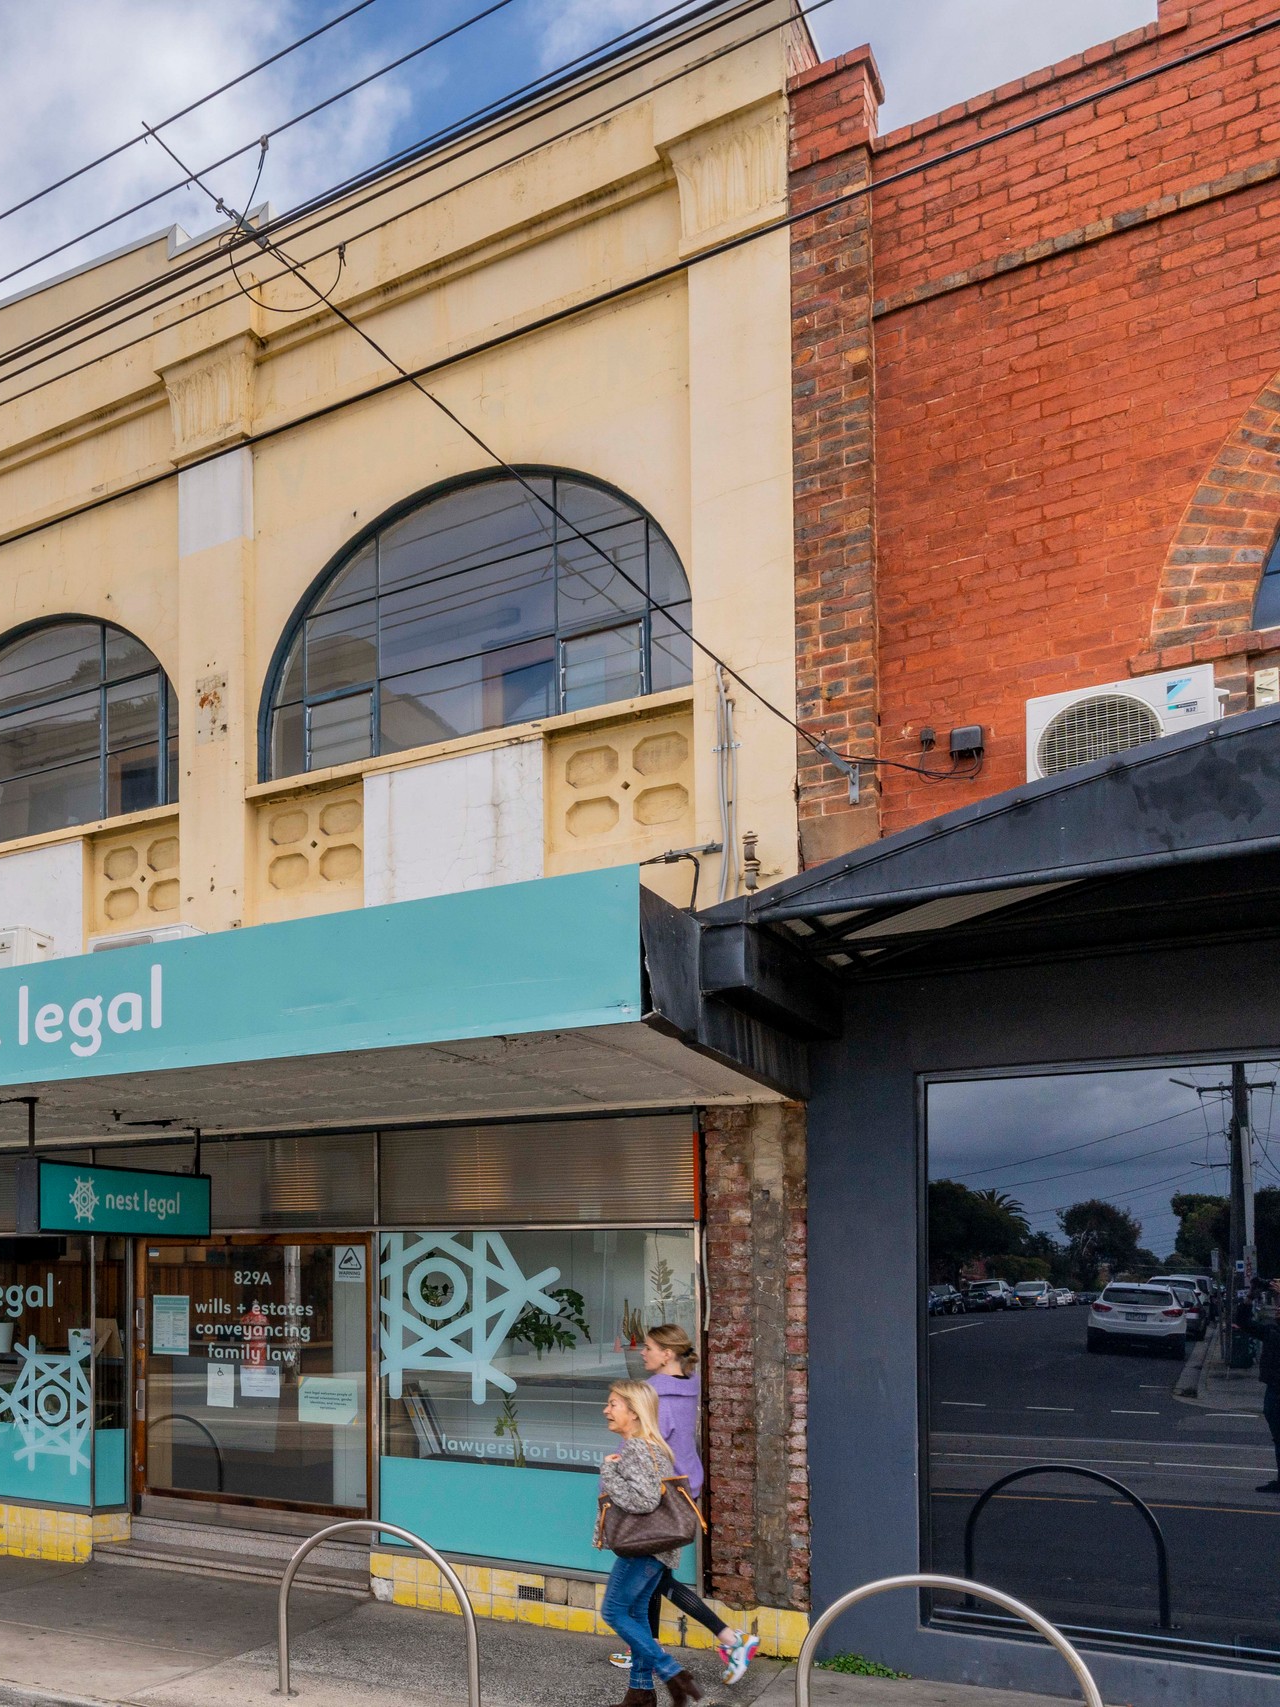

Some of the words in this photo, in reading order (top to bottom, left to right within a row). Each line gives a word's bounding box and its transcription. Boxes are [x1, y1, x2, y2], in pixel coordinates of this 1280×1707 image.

[18, 964, 163, 1057] legal
[105, 1192, 140, 1211] nest
[144, 1189, 180, 1220] legal
[233, 1271, 272, 1286] 829A
[195, 1298, 232, 1314] wills
[236, 1304, 246, 1313] +
[251, 1302, 314, 1316] estates
[195, 1322, 311, 1342] conveyancing
[207, 1342, 261, 1365] family
[266, 1345, 297, 1361] law
[441, 1434, 514, 1458] lawyers
[522, 1439, 549, 1458] for
[556, 1442, 604, 1467] busy
